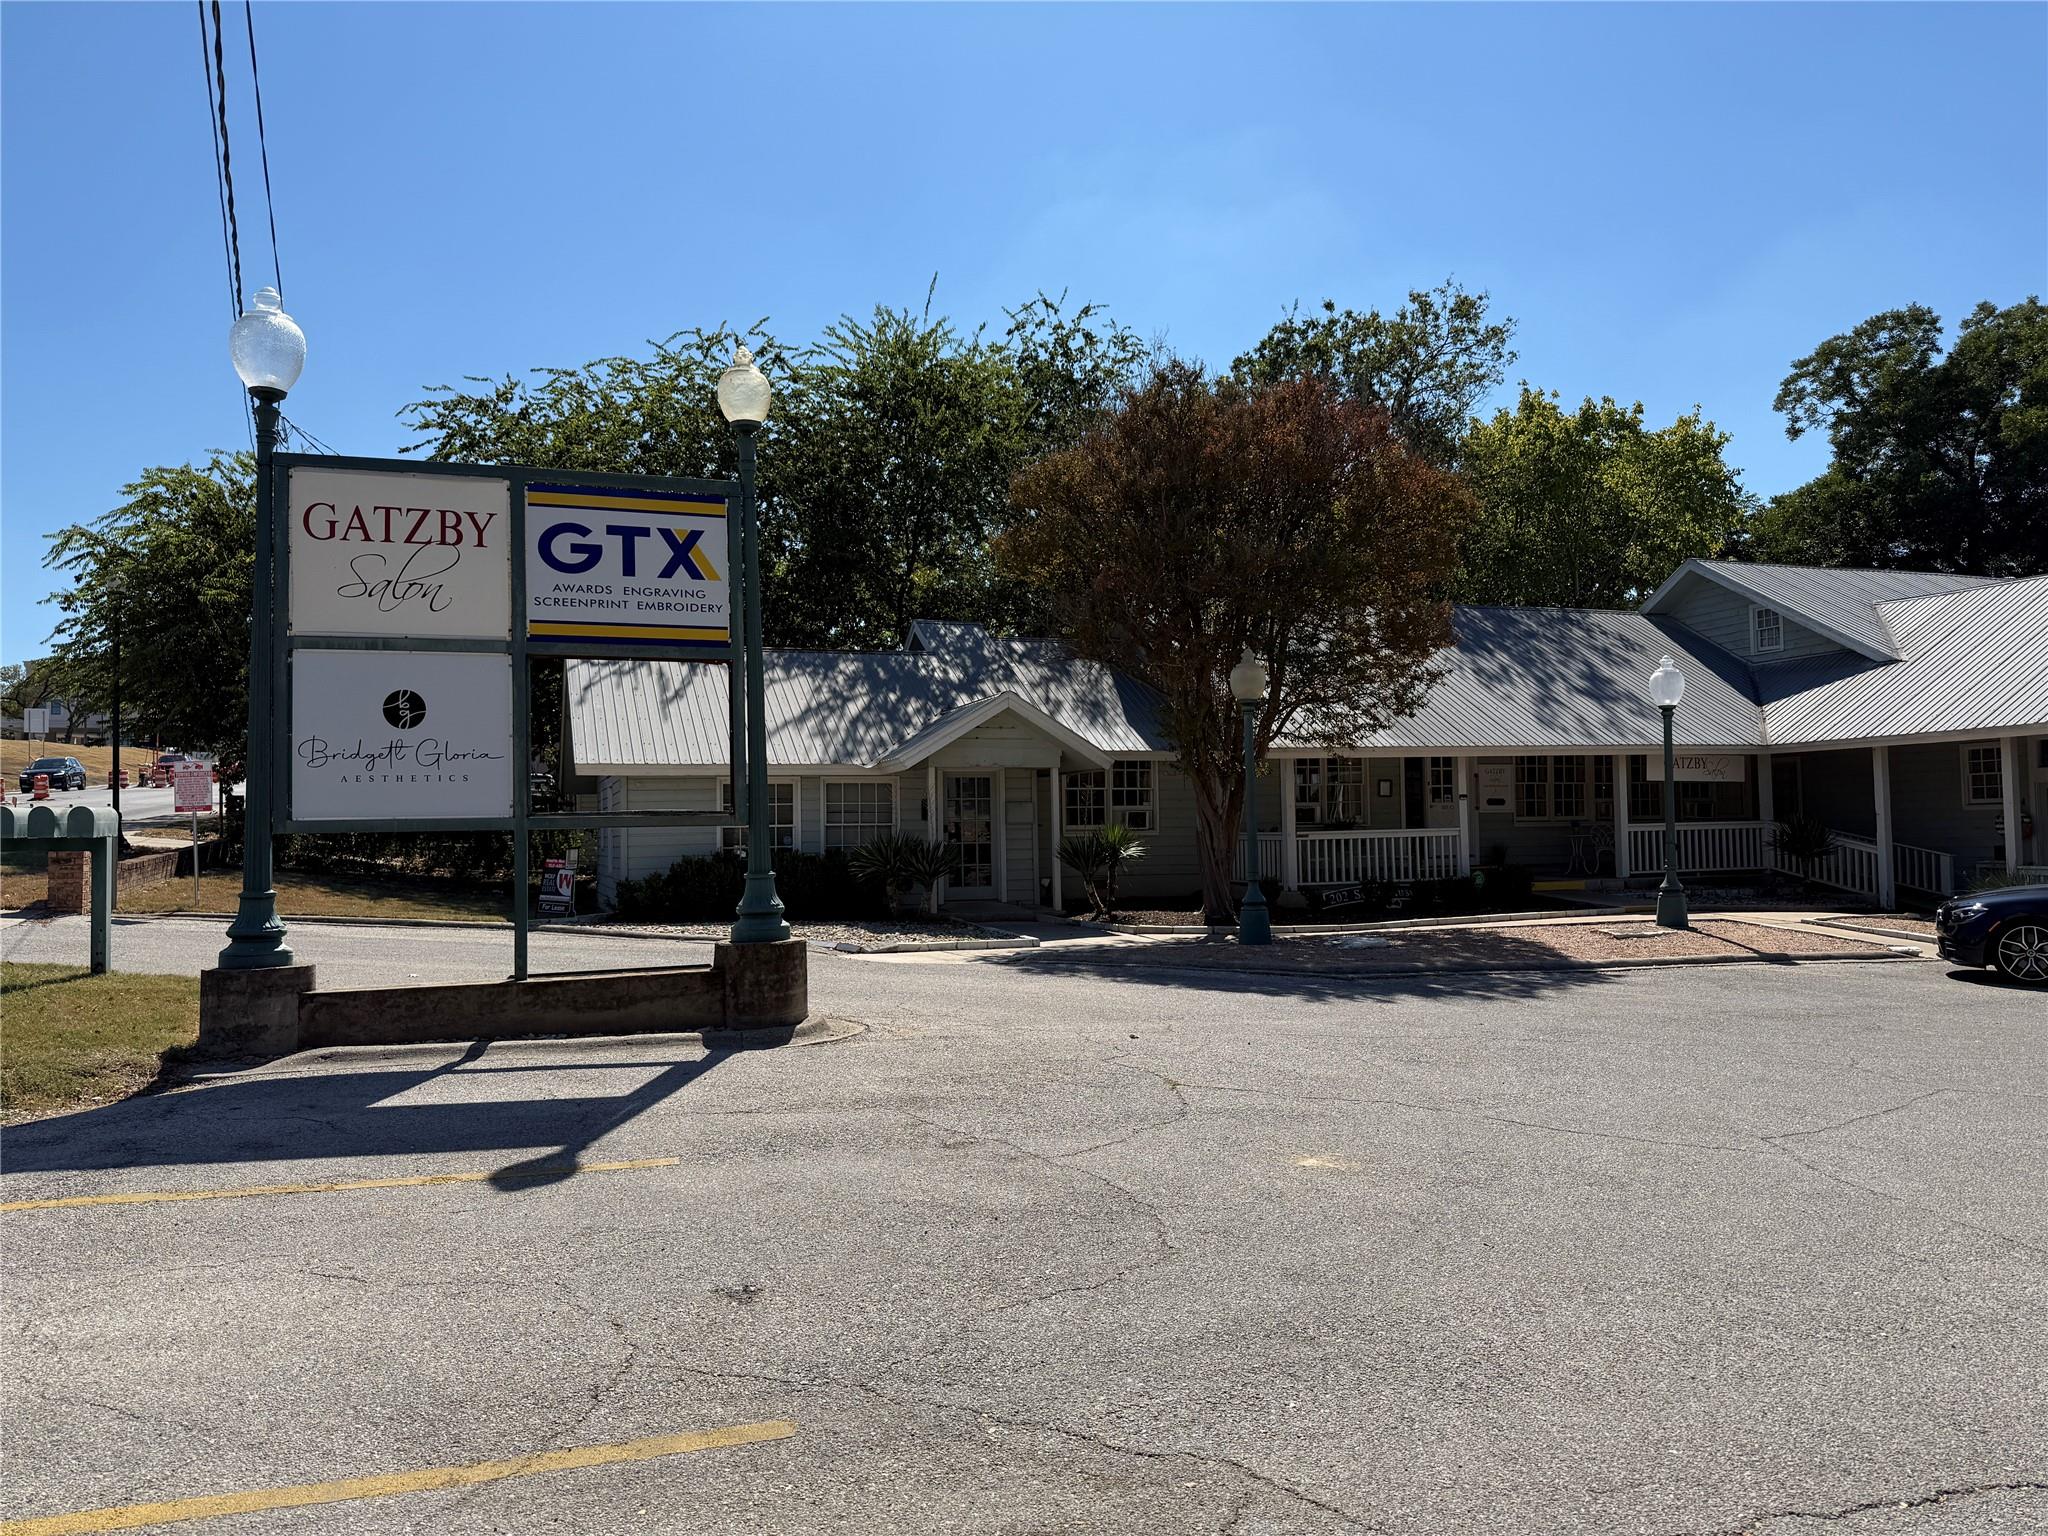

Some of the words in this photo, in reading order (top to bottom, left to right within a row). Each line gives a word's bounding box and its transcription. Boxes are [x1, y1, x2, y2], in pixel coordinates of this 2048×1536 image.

[303, 502, 498, 548] GATZBY
[538, 522, 721, 581] GTX
[337, 541, 461, 613] Salon
[534, 596, 629, 609] SCREENPRINT
[637, 601, 723, 613] EMBROIDERY
[552, 583, 613, 595] AWARDS
[623, 586, 706, 599] ENGRAVING
[298, 735, 414, 772] Bridgett
[415, 738, 504, 770] Gloria
[1673, 757, 1707, 769] ATZBY
[340, 774, 470, 784] AESTHETICS
